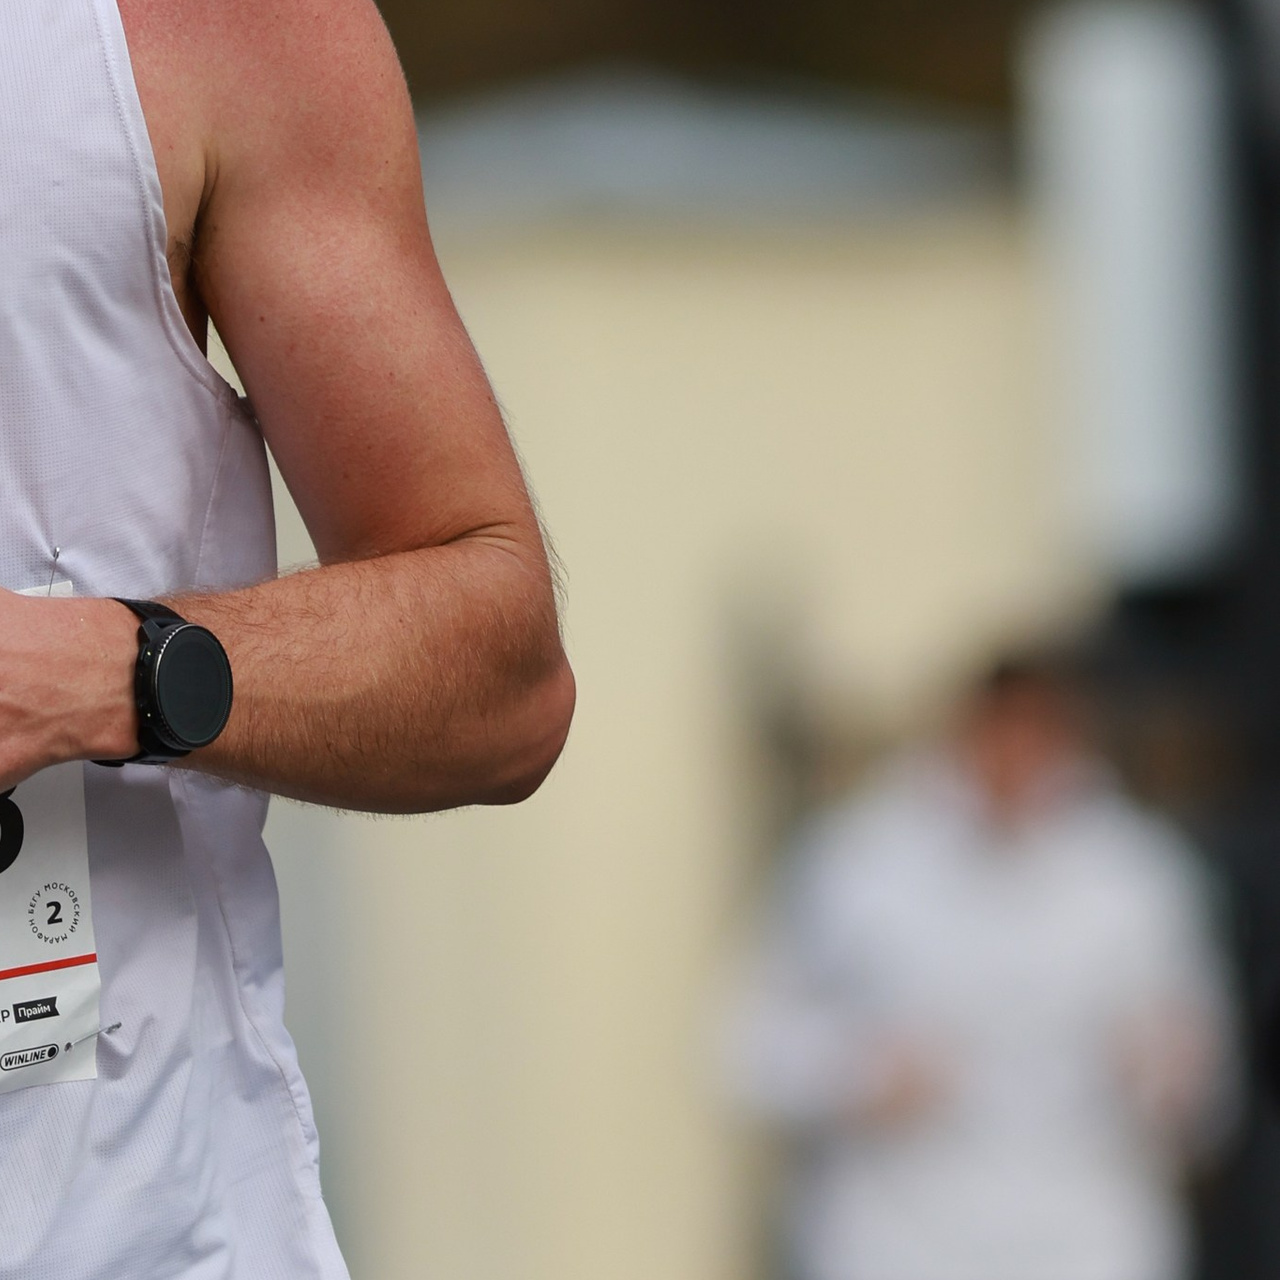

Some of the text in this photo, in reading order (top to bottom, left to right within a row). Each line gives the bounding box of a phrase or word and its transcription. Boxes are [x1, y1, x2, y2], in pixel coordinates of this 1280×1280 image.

[44, 882, 81, 933] МОСКОВСКИЙ
[46, 901, 63, 925] 2
[28, 918, 68, 944] МАРАФОН
[17, 1004, 51, 1018] Прайм
[4, 1049, 47, 1067] WINLINE
